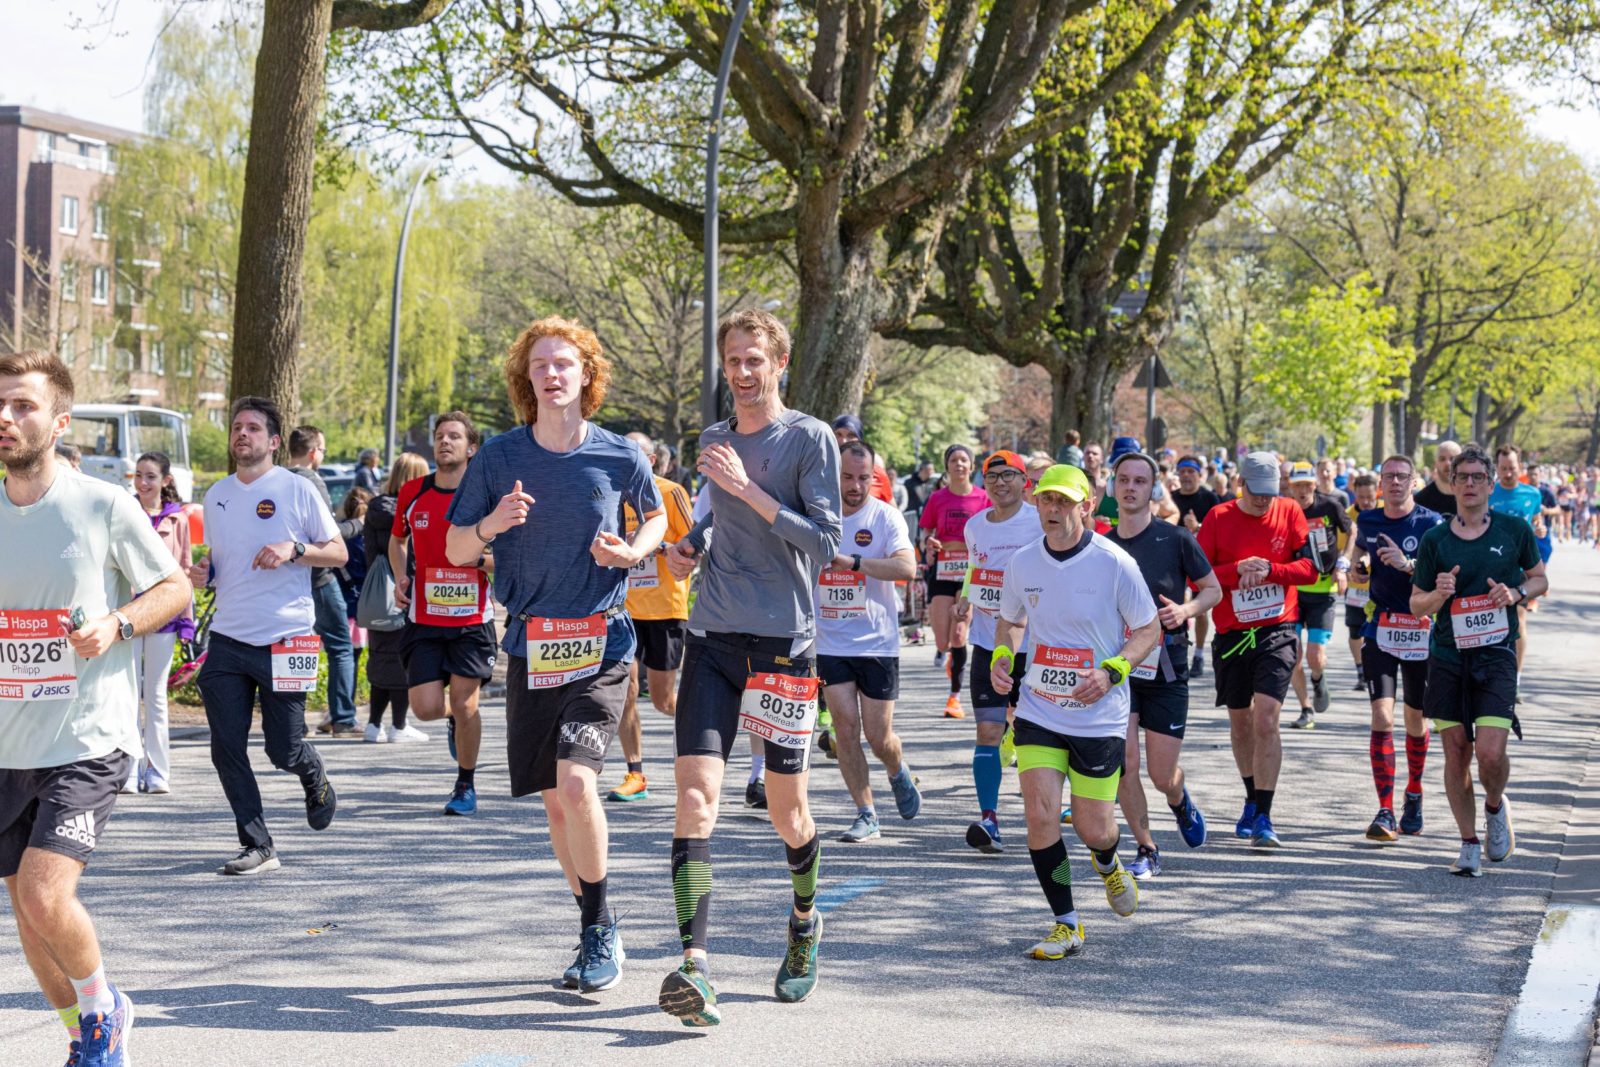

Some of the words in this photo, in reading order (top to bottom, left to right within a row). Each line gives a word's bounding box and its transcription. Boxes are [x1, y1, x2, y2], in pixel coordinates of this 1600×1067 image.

[445, 571, 467, 579] Haspa
[833, 573, 854, 582] Haspa
[988, 573, 1004, 583] Hasp
[433, 585, 468, 598] 20244
[827, 588, 854, 601] 7136
[980, 588, 1003, 602] 204
[1238, 585, 1278, 603] 12011
[1470, 599, 1493, 607] Haspa
[11, 616, 48, 632] Haspa
[1466, 612, 1496, 628] 6482
[556, 621, 589, 632] Haspa
[1386, 630, 1421, 642] 10545
[58, 639, 68, 649] H
[295, 640, 320, 649] Haspa
[540, 639, 592, 661] 22324
[596, 636, 603, 645] E
[288, 656, 317, 670] 9388
[555, 658, 580, 668] Laszlo
[594, 650, 601, 659] 3
[1051, 651, 1079, 663] Haspa
[12, 664, 41, 676] Philipp
[535, 675, 563, 686] REWE
[579, 667, 596, 676] asics
[1041, 668, 1077, 687] 6233
[44, 685, 70, 696] asics
[278, 681, 301, 689] REWE
[778, 678, 809, 695] Haspa
[1045, 683, 1068, 693] Lothar
[760, 693, 807, 721] 8035
[808, 700, 815, 710] G
[1068, 701, 1087, 709] asics
[762, 710, 796, 728] Andreas
[743, 720, 772, 738] REWE
[787, 736, 807, 746] asics
